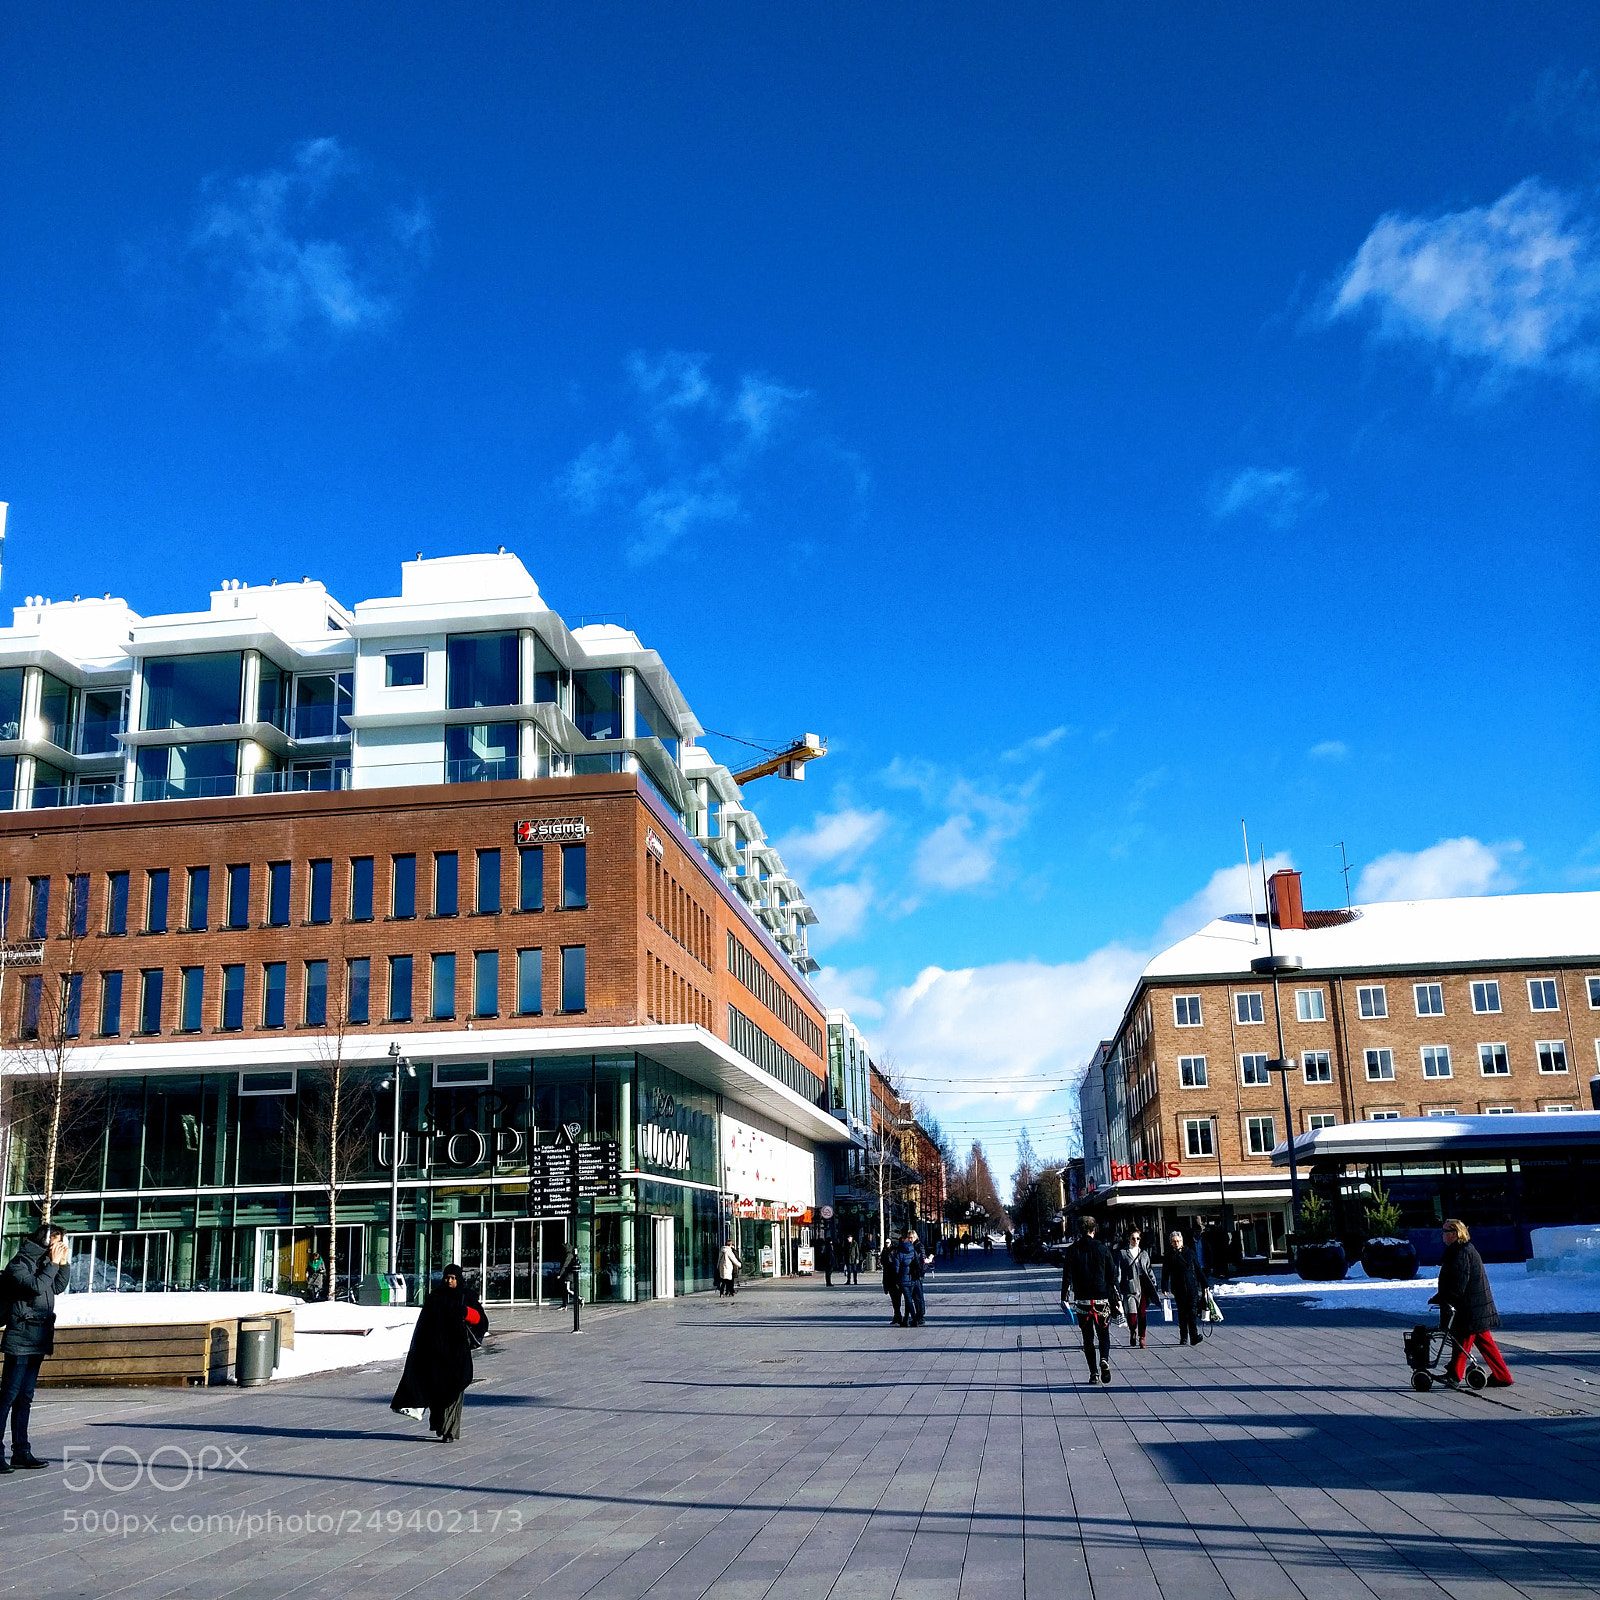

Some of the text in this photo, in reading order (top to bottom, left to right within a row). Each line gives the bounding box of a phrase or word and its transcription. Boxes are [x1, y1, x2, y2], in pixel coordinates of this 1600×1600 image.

[374, 1119, 583, 1171] UTOPIA
[638, 1123, 691, 1171] UTOPIA
[740, 1198, 754, 1207] MAX
[787, 1205, 799, 1213] MAX
